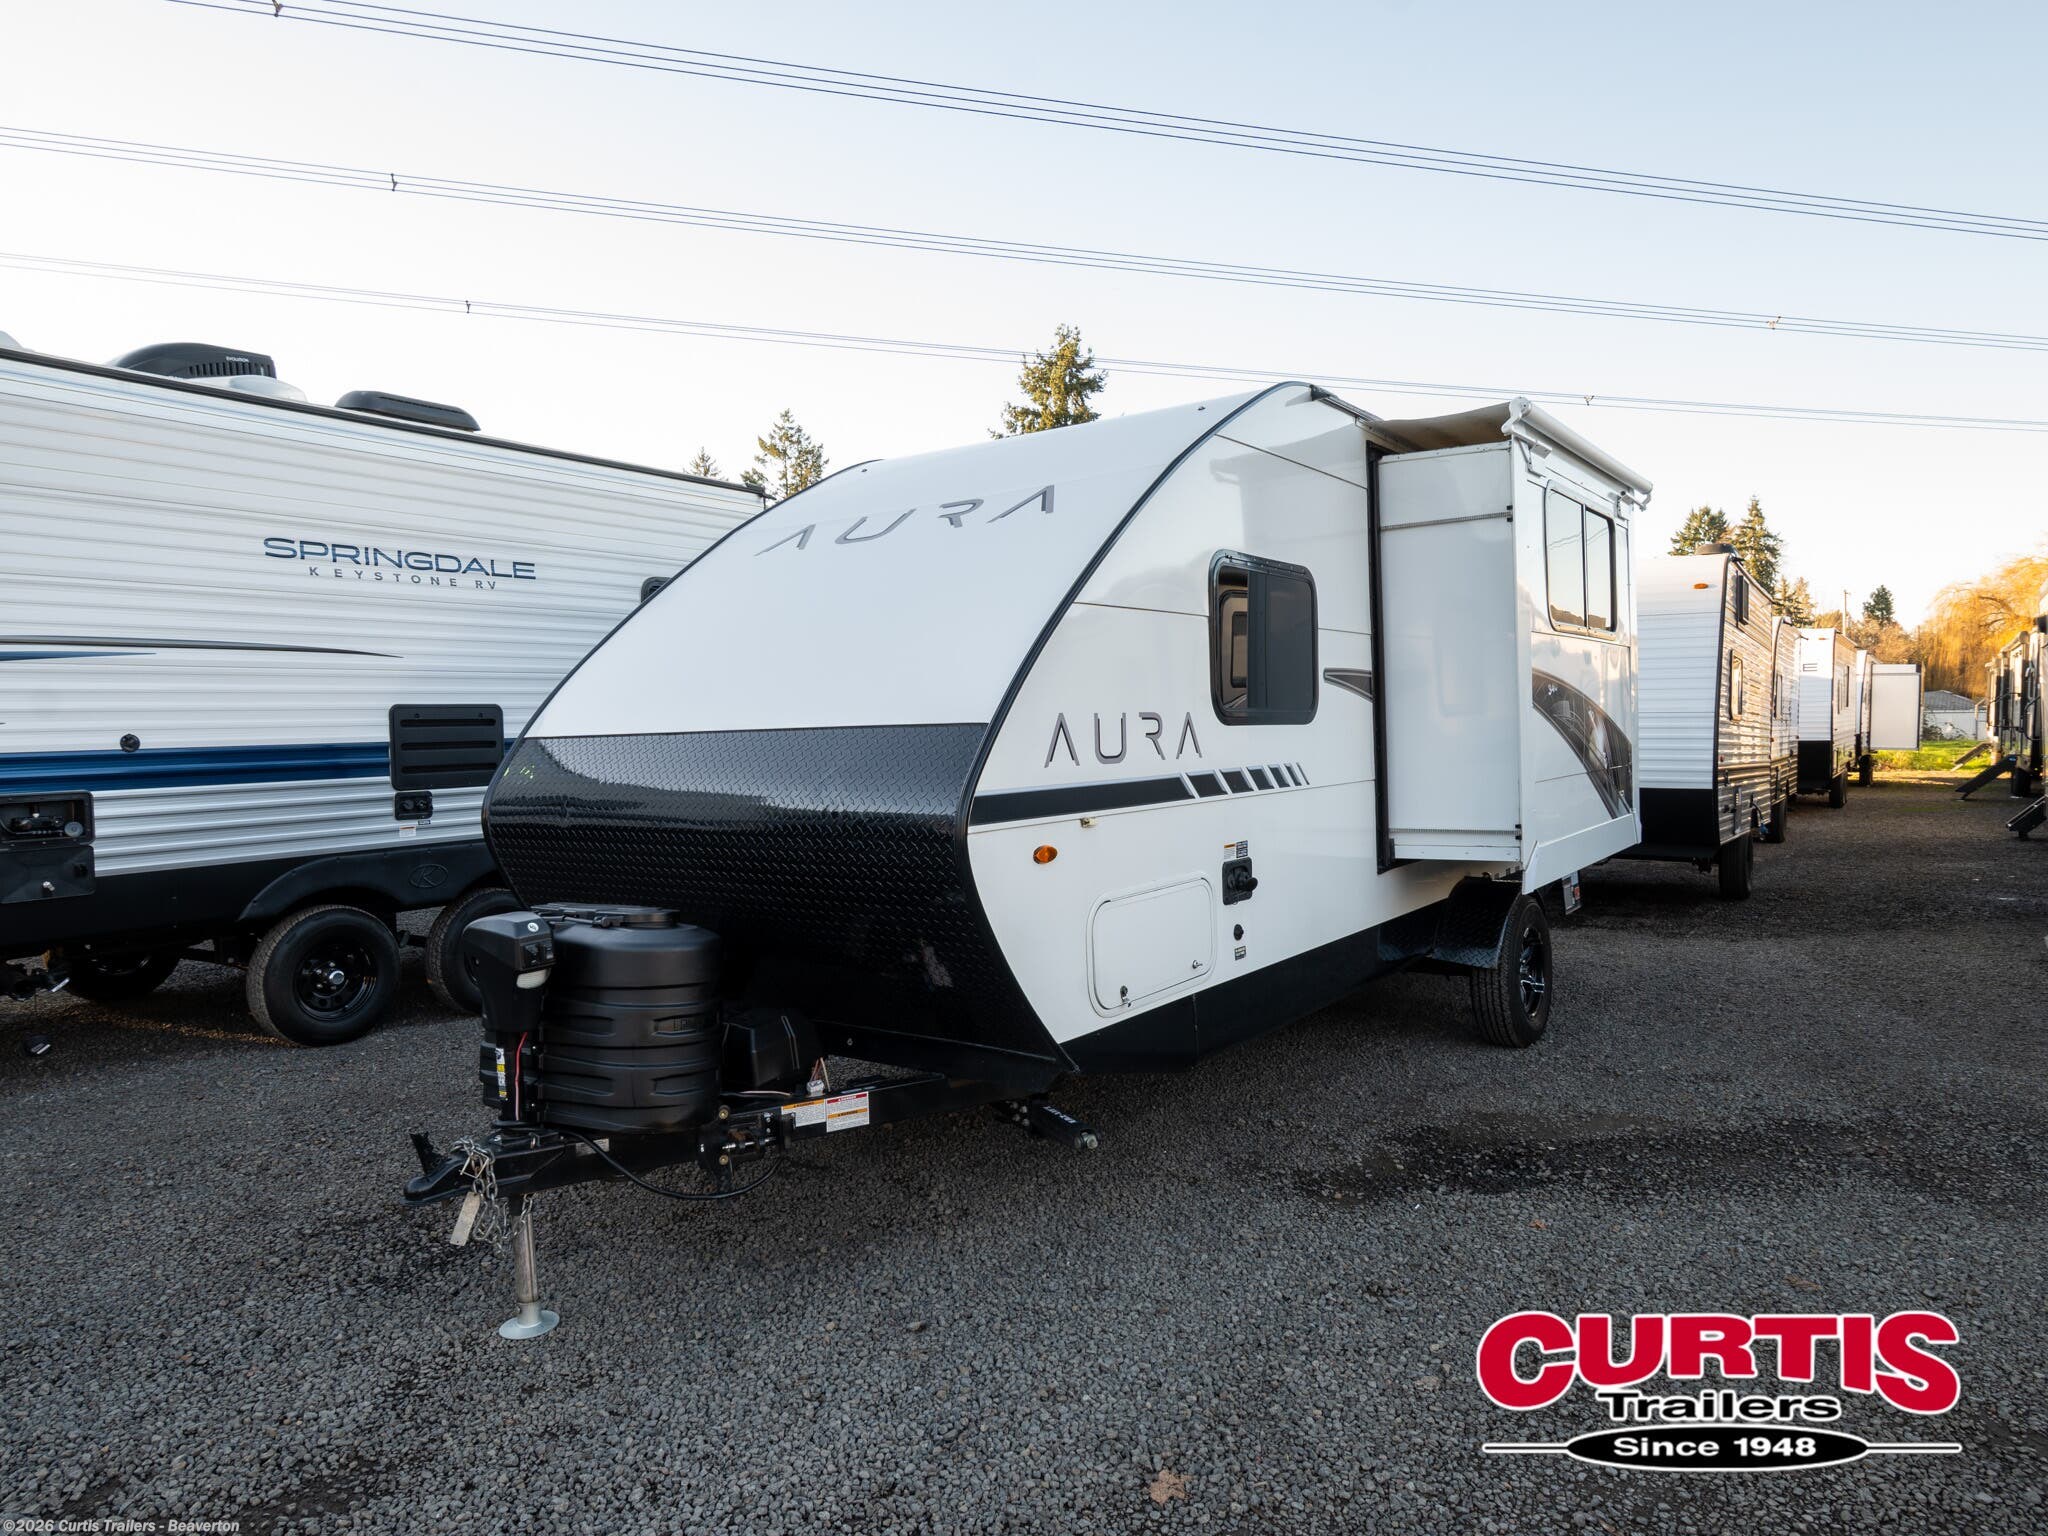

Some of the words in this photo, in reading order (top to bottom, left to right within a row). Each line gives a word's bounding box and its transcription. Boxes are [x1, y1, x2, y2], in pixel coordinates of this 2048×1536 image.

[753, 484, 1055, 557] AURA
[264, 537, 536, 580] SPRINGDALE
[309, 566, 457, 587] KEYSTONE
[475, 579, 496, 590] RV
[1044, 711, 1202, 769] AURA
